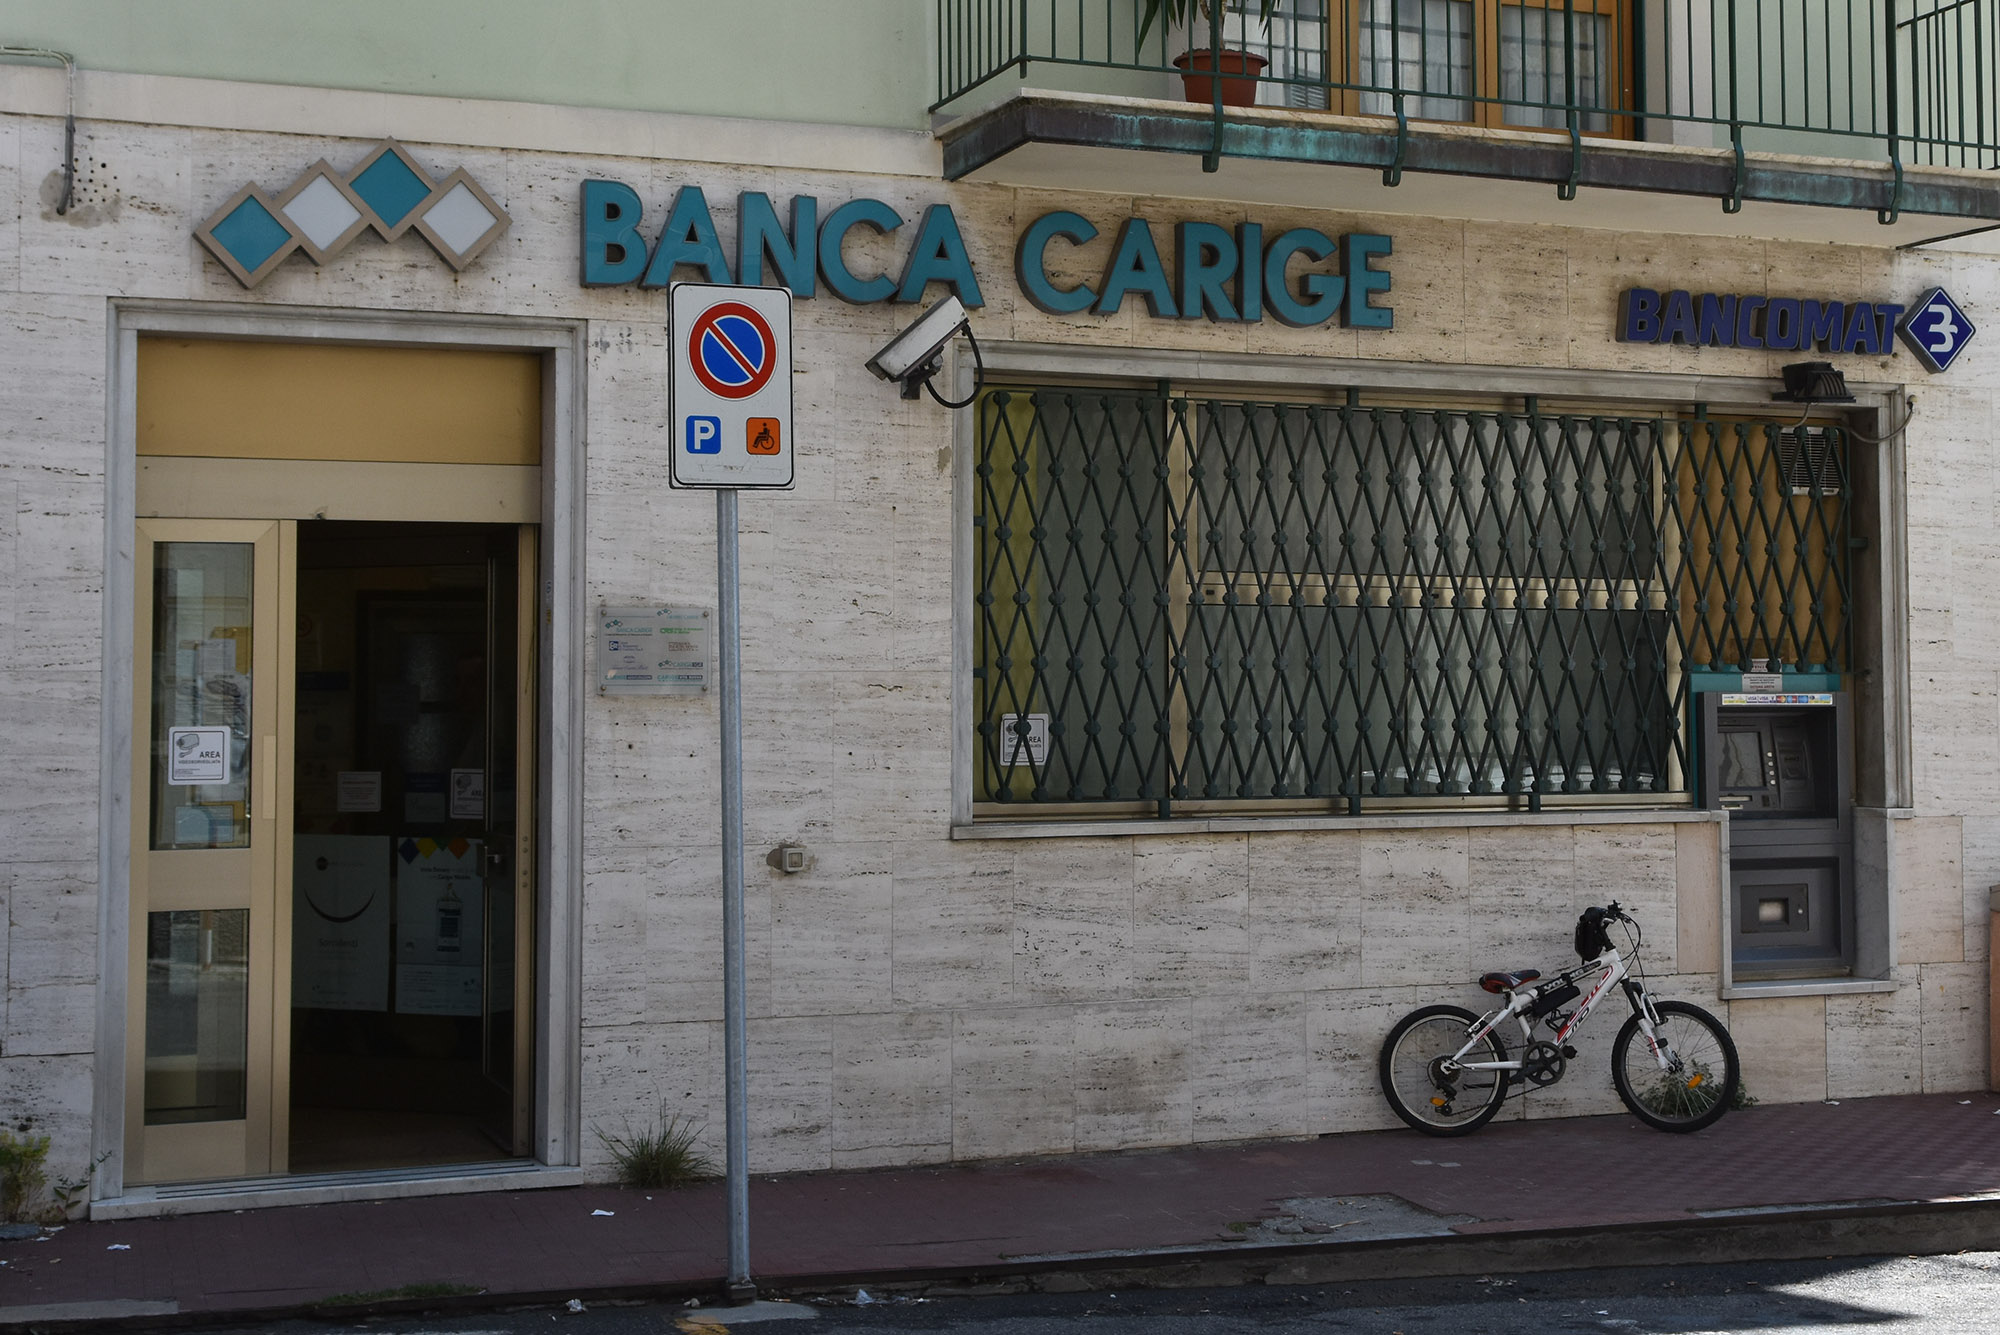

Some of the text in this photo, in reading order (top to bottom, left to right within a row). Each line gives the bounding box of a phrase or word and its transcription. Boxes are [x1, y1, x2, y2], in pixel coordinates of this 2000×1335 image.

[580, 178, 1394, 329] BANCA CARIGE
[1616, 288, 1905, 355] BANCOMAT
[693, 420, 716, 451] P
